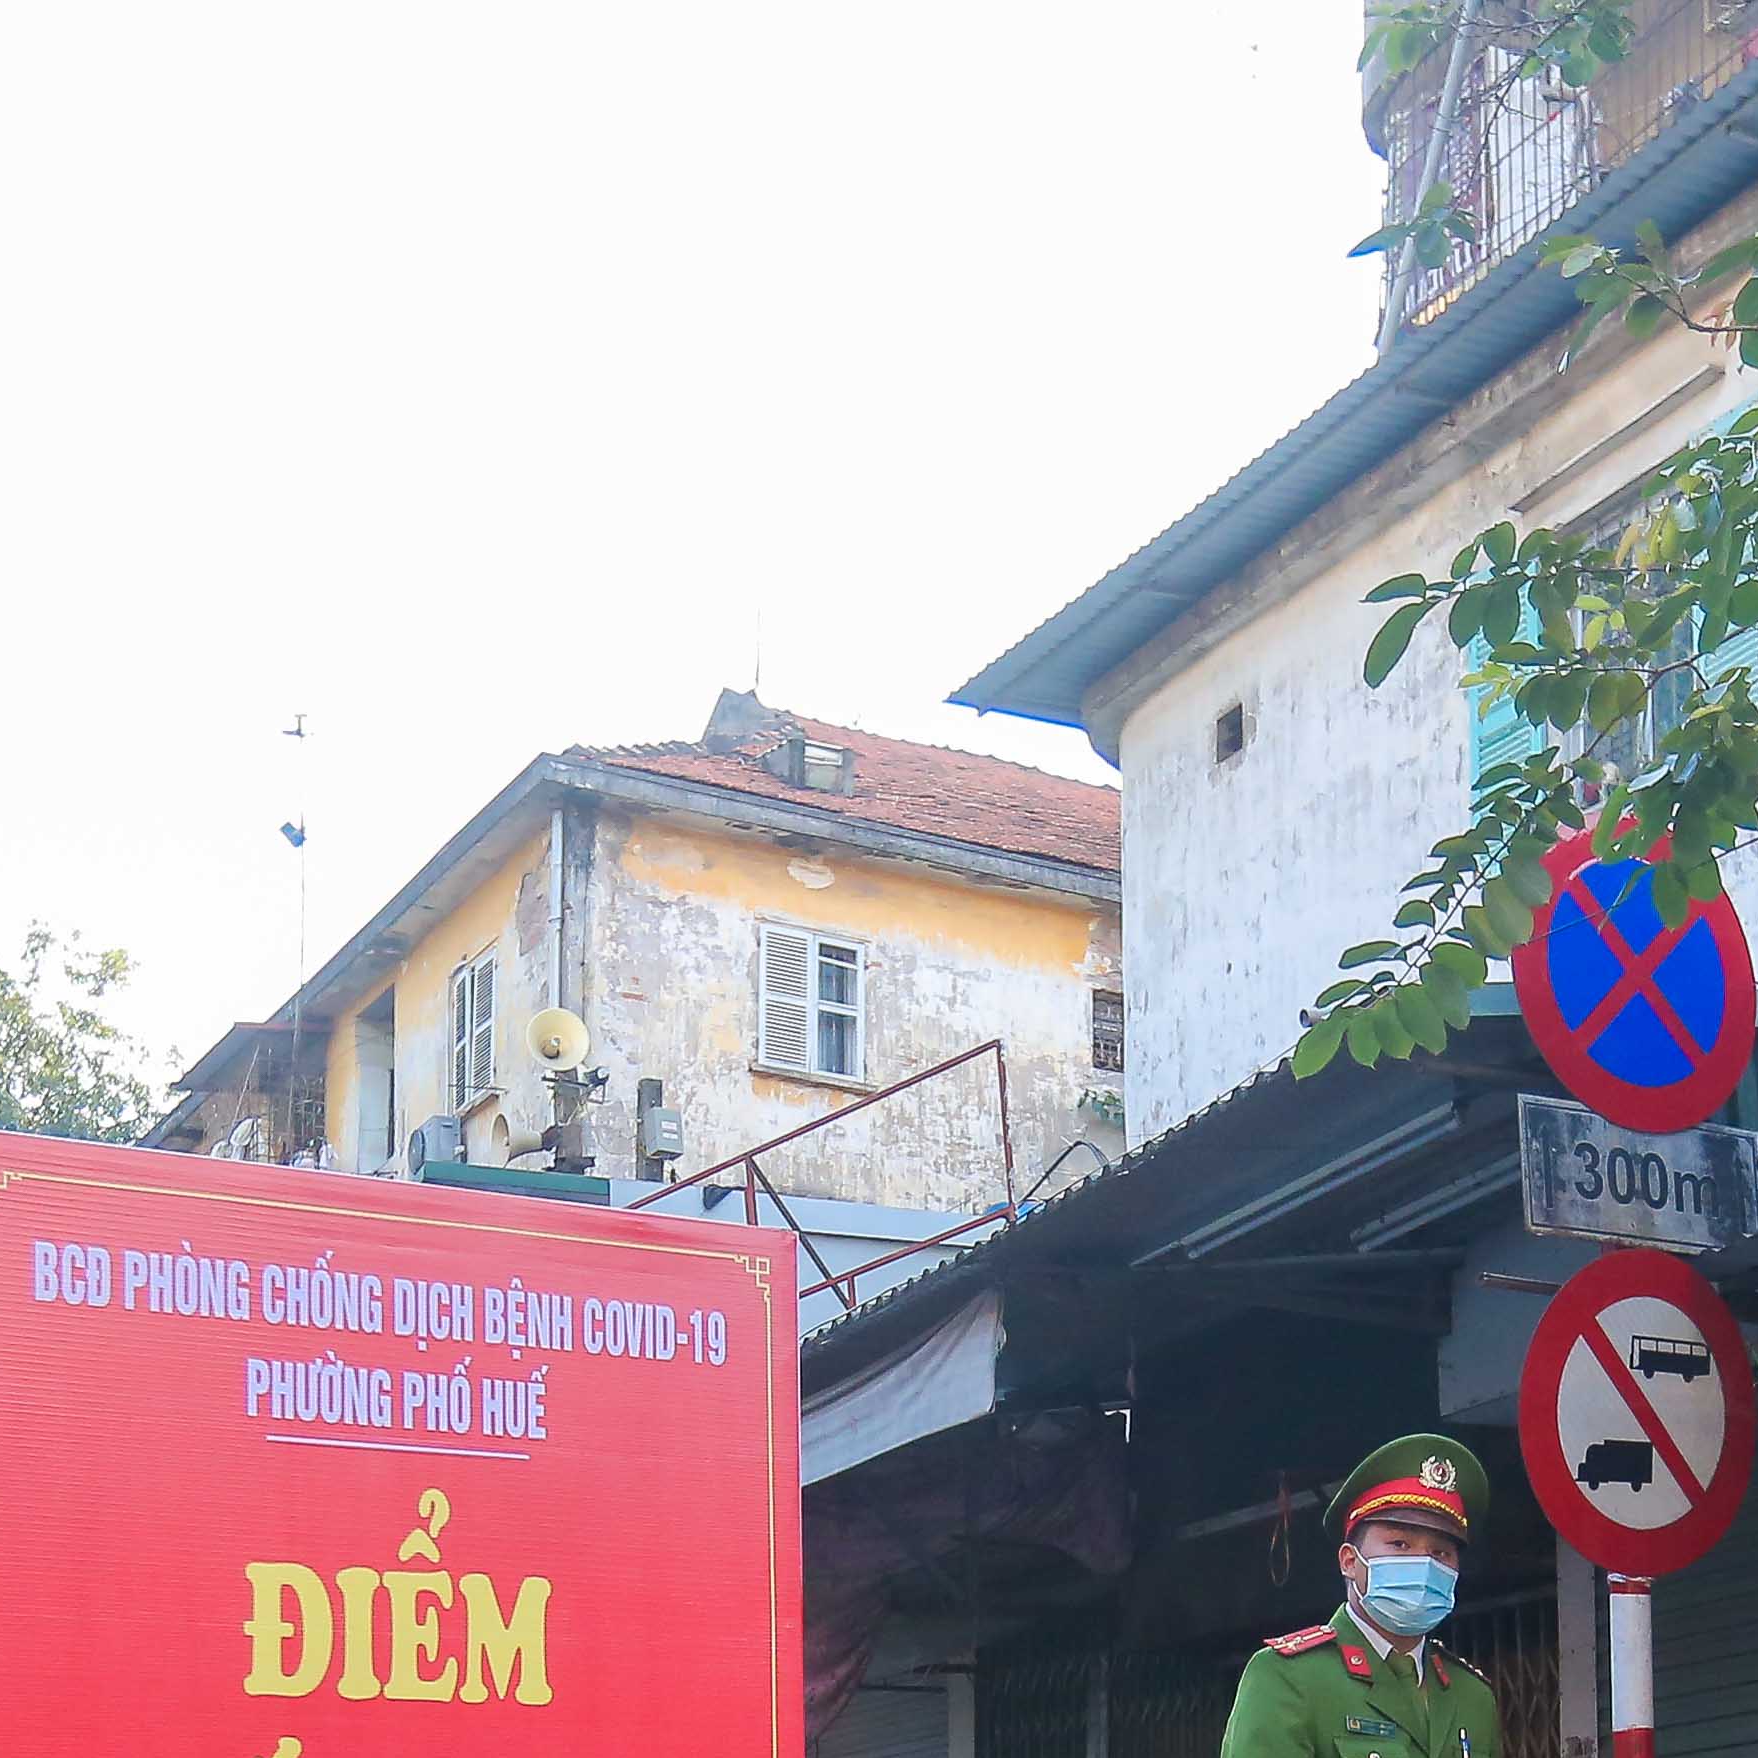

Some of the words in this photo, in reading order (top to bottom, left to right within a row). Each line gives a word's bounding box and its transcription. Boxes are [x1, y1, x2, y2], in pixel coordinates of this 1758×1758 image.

[1574, 1141, 1721, 1220] 300m
[33, 1239, 112, 1307] BCĐ
[123, 1239, 251, 1323] PHÒNG
[262, 1249, 384, 1336] CHỐNG
[392, 1277, 474, 1352] DỊCH
[483, 1277, 574, 1360] BỆNH
[582, 1297, 728, 1367] COVID-19
[245, 1348, 393, 1430] PHƯỜNG
[402, 1355, 473, 1434] PHỐ
[482, 1364, 549, 1441] HUẾ
[243, 1487, 553, 1706] ĐIỂM
